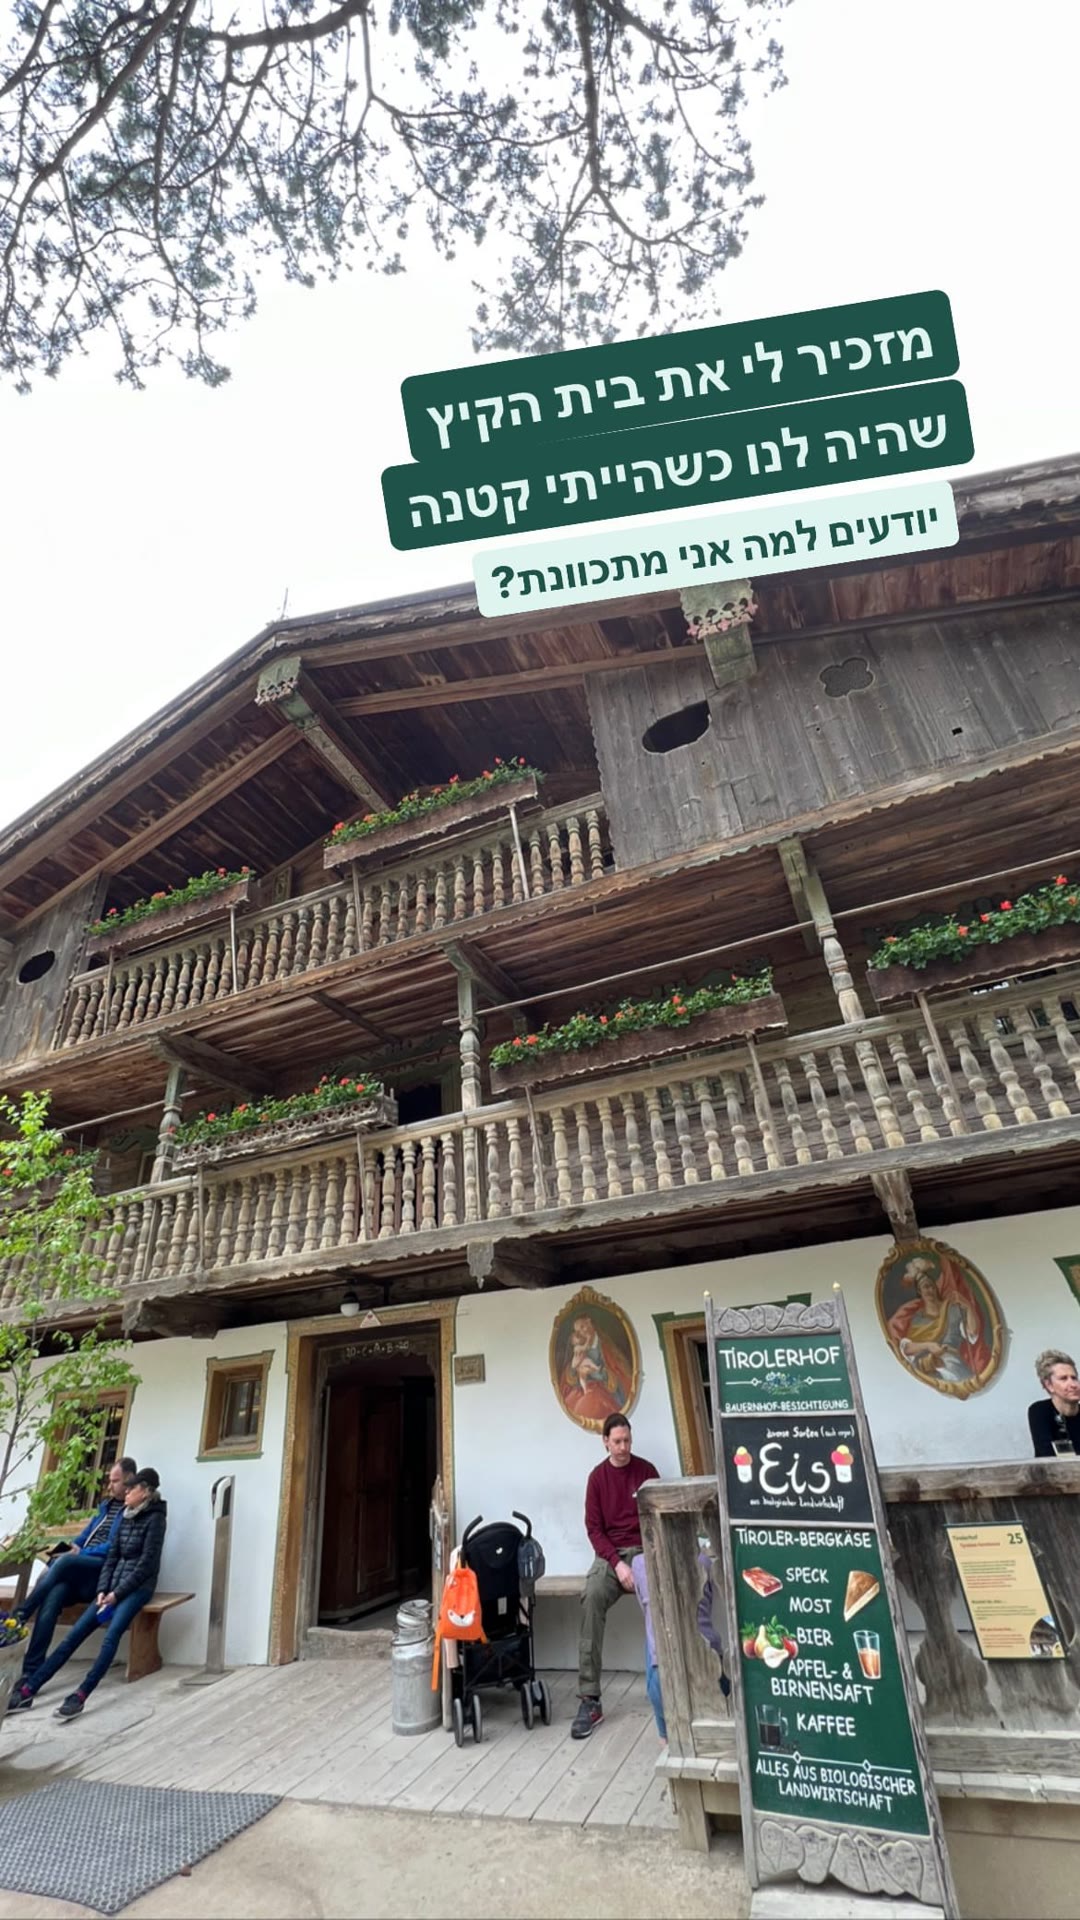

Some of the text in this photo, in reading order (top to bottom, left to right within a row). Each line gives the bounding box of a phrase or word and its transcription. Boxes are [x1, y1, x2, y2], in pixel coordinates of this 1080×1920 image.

[725, 1400, 849, 1413] BAUERNHOF-BESICHTIGUNG
[792, 1425, 819, 1439] Sorten
[759, 1442, 831, 1494] Eis
[1007, 1533, 1023, 1544] 25
[786, 1567, 829, 1584] SPECK
[789, 1597, 832, 1614] MOST
[796, 1627, 834, 1647] BIER
[787, 1659, 853, 1680] APFEL- &
[771, 1677, 874, 1705] BIRNENSAFT
[796, 1713, 856, 1737] KAFFEE
[755, 1758, 917, 1795] ALLES AUS BIOLOGISCHER
[778, 1779, 893, 1813] LANDWIRTSCHAFT
